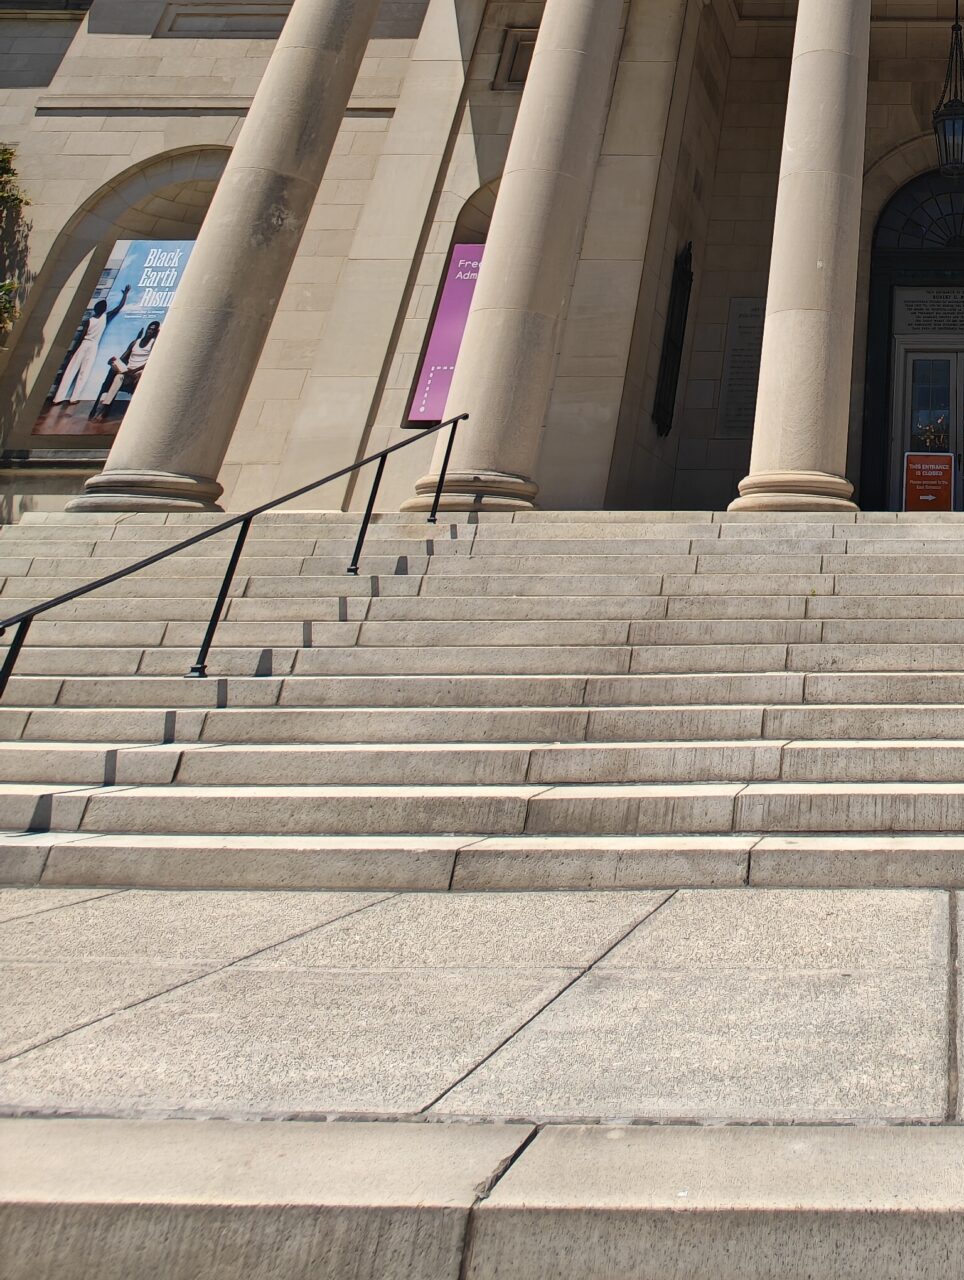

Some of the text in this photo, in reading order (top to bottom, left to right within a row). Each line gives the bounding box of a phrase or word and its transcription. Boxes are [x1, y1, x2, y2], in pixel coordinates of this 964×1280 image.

[144, 248, 184, 267] Black
[137, 267, 178, 287] Earth
[455, 271, 479, 280] Adm
[139, 287, 177, 307] Risin
